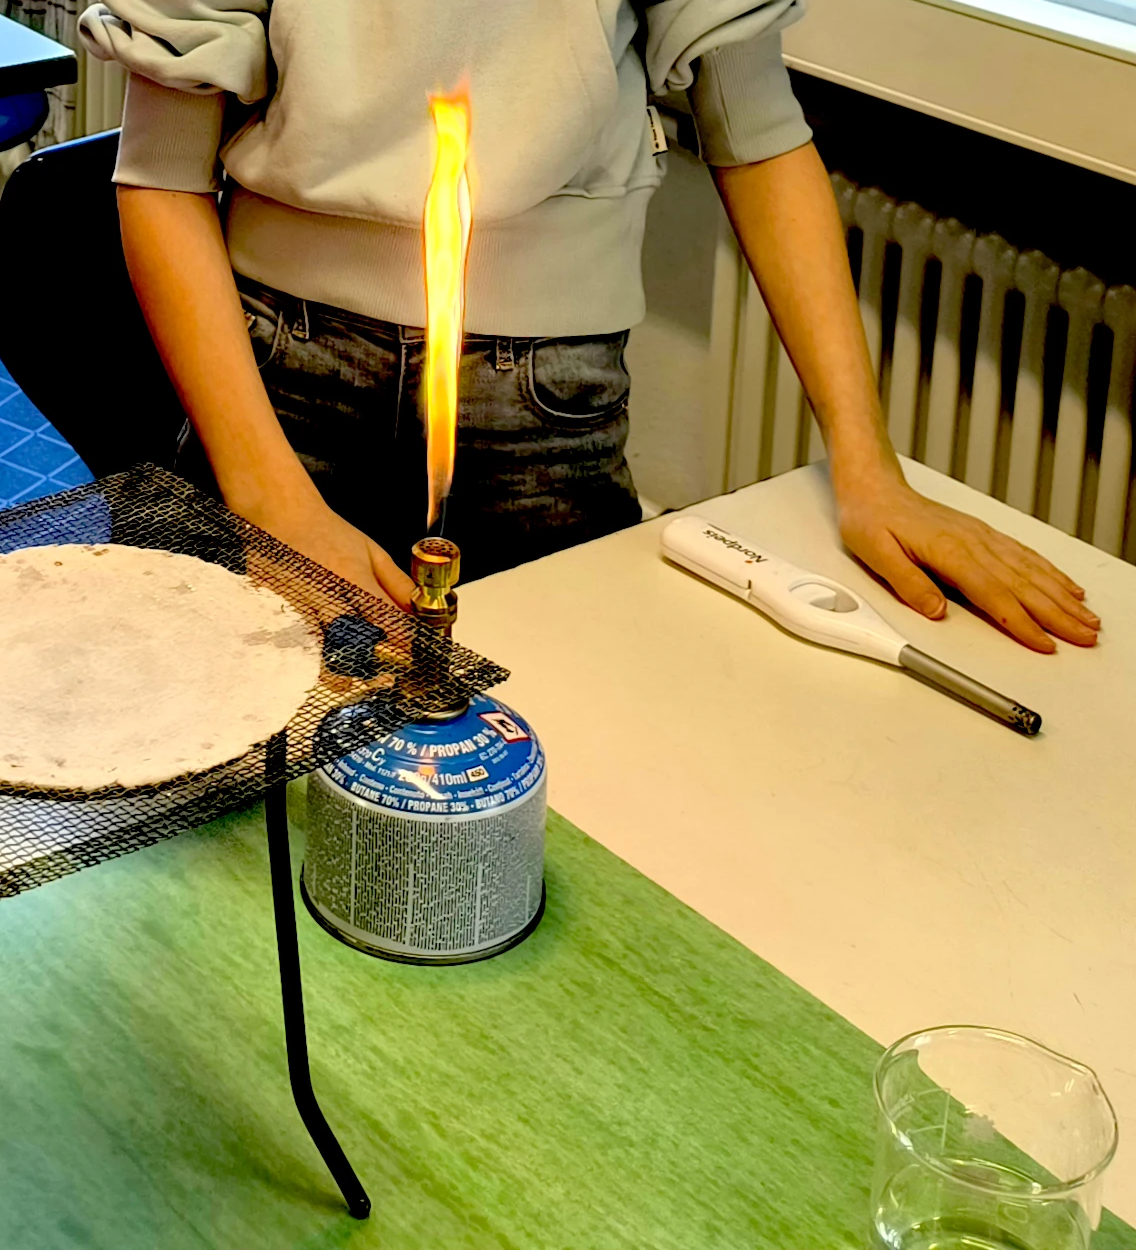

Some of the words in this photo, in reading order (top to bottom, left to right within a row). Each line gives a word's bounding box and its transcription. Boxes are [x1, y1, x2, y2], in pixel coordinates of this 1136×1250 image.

[703, 529, 768, 563] Nordpeis
[388, 737, 405, 751] 70
[429, 739, 477, 758] PROPAN
[473, 733, 490, 747] 30
[350, 781, 381, 802] BUTANE
[381, 794, 400, 808] 70%
[407, 798, 449, 812] PROPANE
[449, 799, 470, 812] 30%
